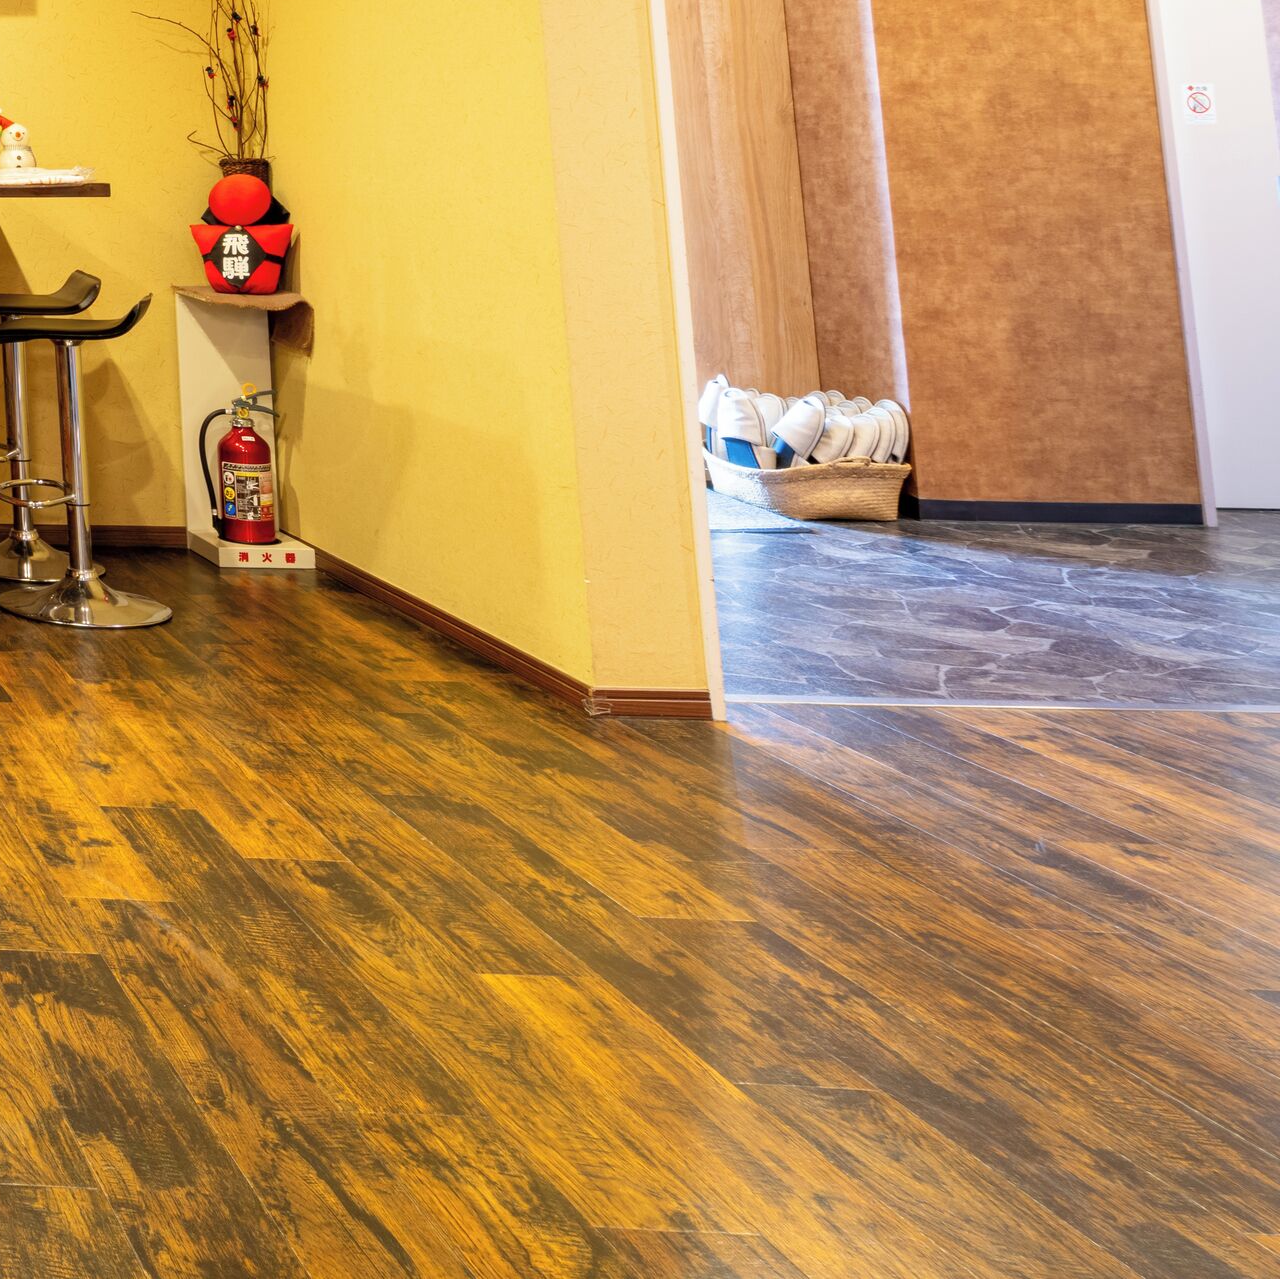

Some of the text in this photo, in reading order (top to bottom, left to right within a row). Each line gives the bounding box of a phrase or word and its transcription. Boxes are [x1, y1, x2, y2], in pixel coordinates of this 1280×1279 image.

[222, 233, 250, 280] 飛騨
[238, 551, 296, 564] 消火器
